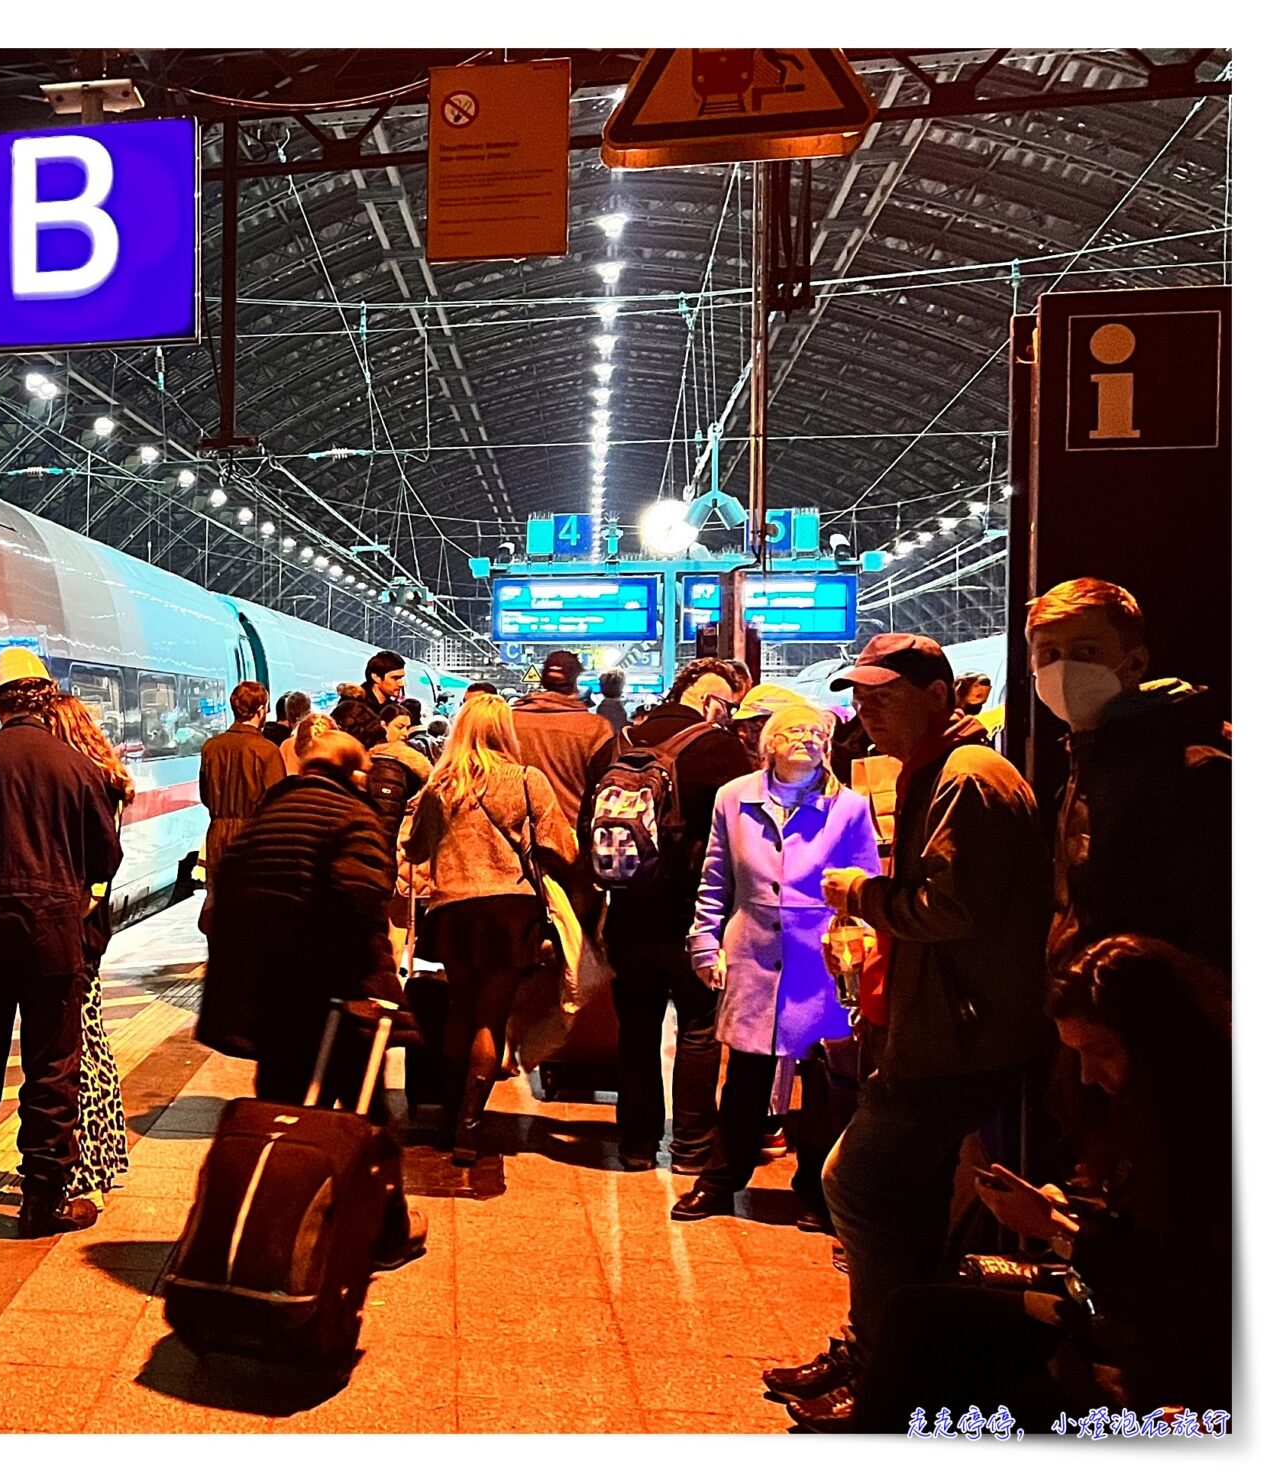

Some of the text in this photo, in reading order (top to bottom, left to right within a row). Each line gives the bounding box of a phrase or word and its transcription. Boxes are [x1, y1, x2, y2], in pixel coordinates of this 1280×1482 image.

[10, 135, 120, 301] B
[1089, 323, 1141, 439] i
[559, 515, 581, 546] 4
[765, 510, 786, 543] 5
[506, 643, 519, 659] C
